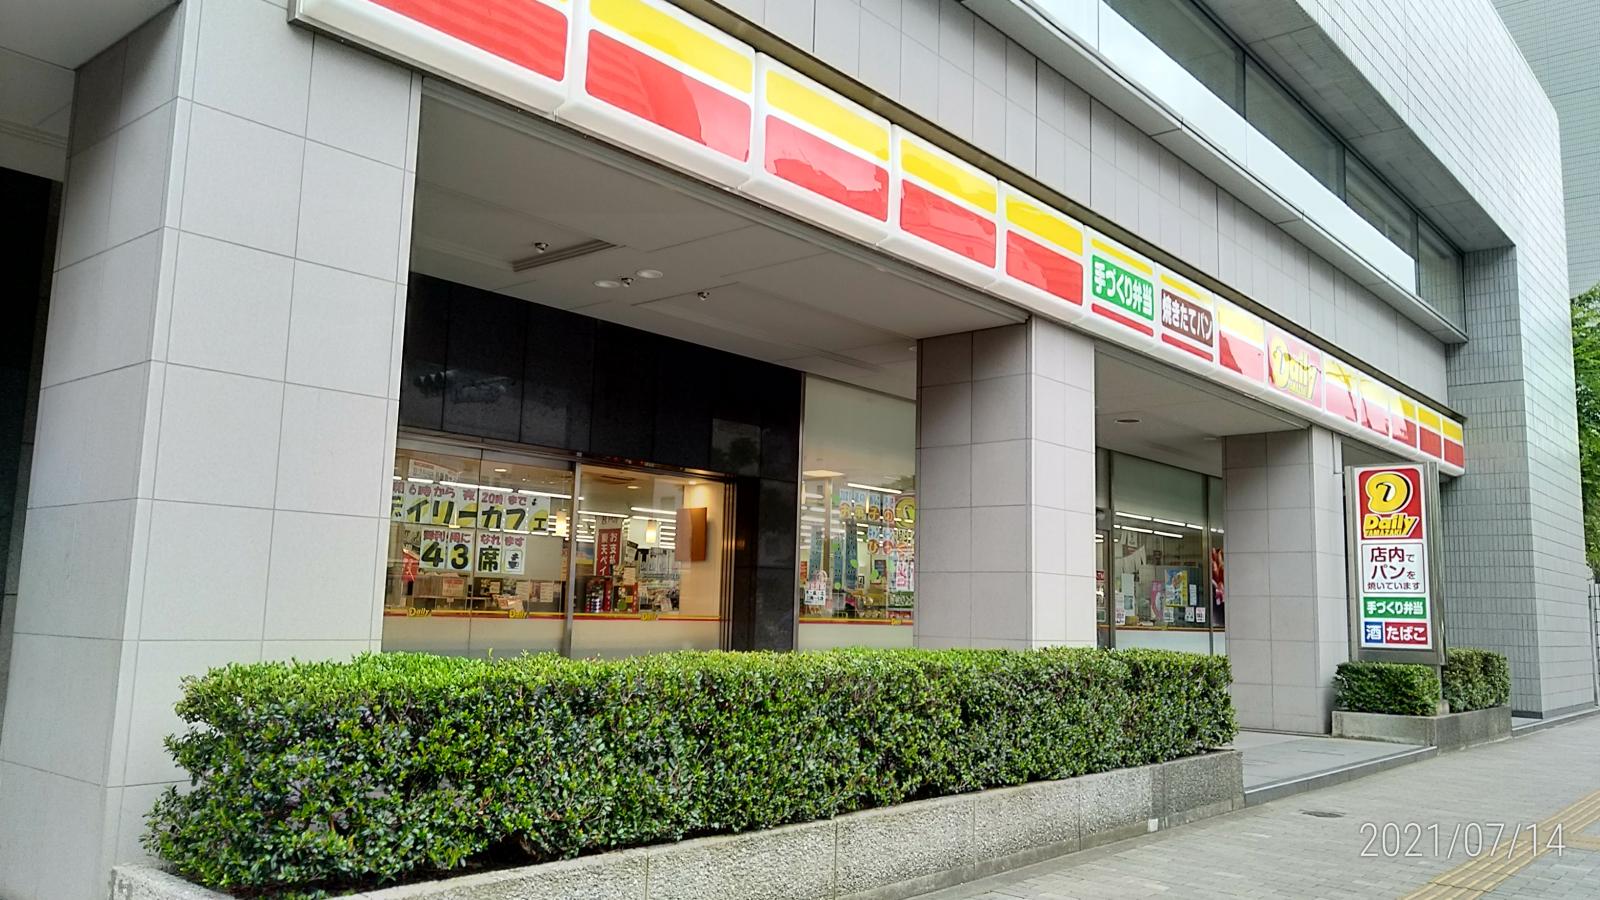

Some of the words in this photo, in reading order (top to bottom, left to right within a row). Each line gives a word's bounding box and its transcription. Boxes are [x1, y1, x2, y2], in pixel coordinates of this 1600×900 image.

[1094, 262, 1153, 316] 手づくり弁当
[1162, 293, 1213, 341] 焼きたてパン
[1271, 335, 1318, 399] Daily
[1363, 513, 1419, 537] Daily
[421, 542, 500, 572] 43席
[1370, 547, 1414, 563] 店内で
[1371, 565, 1415, 580] パンを
[1367, 581, 1420, 590] 焼いています
[407, 607, 431, 618] Daily
[1366, 601, 1423, 615] 手づくり弁当
[1365, 625, 1382, 641] 酒
[1386, 625, 1426, 641] たばこ
